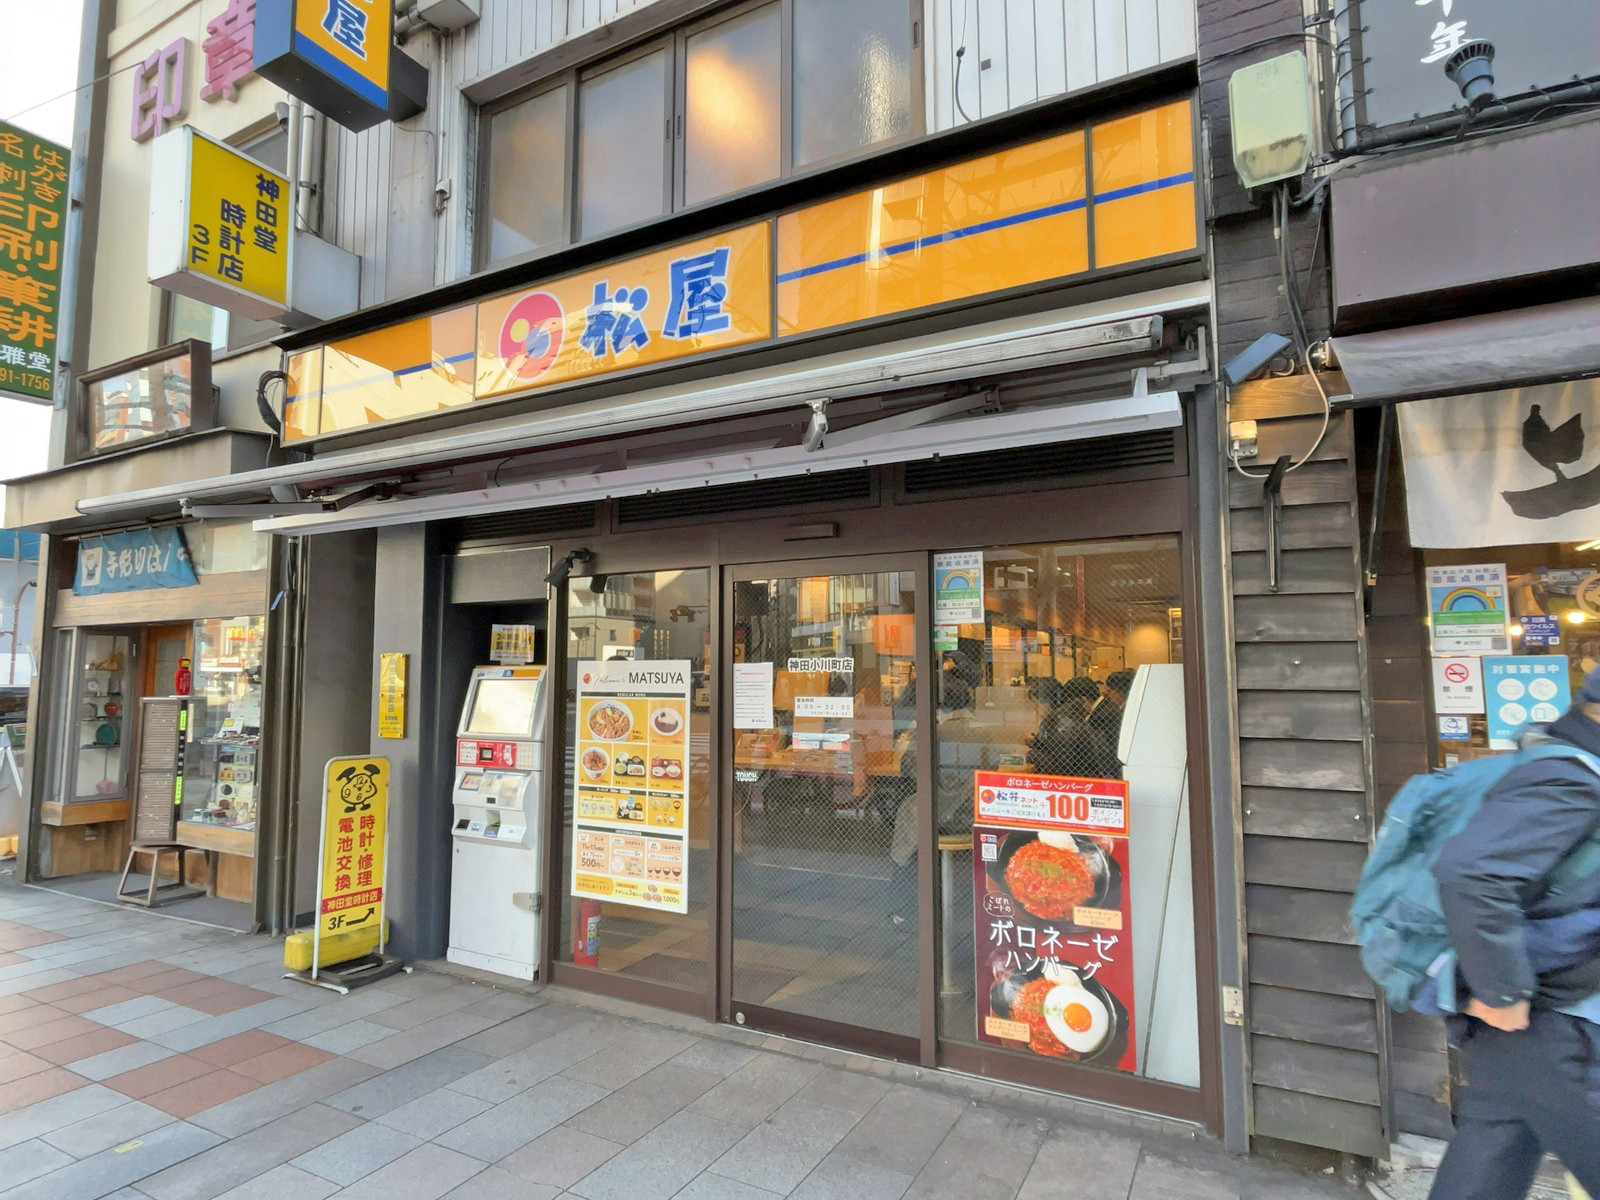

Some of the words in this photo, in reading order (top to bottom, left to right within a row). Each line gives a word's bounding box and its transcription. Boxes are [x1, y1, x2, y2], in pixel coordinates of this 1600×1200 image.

[30, 143, 68, 203] はがき
[254, 171, 280, 255] 神田堂
[191, 223, 210, 265] 3F
[217, 197, 247, 283] 時計店
[577, 245, 733, 359] 松屋
[628, 671, 684, 685] MATSUYA
[788, 658, 854, 672] 神田小川町店
[1006, 777, 1095, 793] ボロネーゼハンバーグ
[335, 816, 355, 892] 電池交換
[356, 813, 376, 888] 時計・修理
[326, 890, 379, 911] 神田堂時計店
[328, 914, 346, 931] 3F
[990, 920, 1119, 962] ボロネーゼ
[1004, 950, 1103, 981] ハンバーグ
